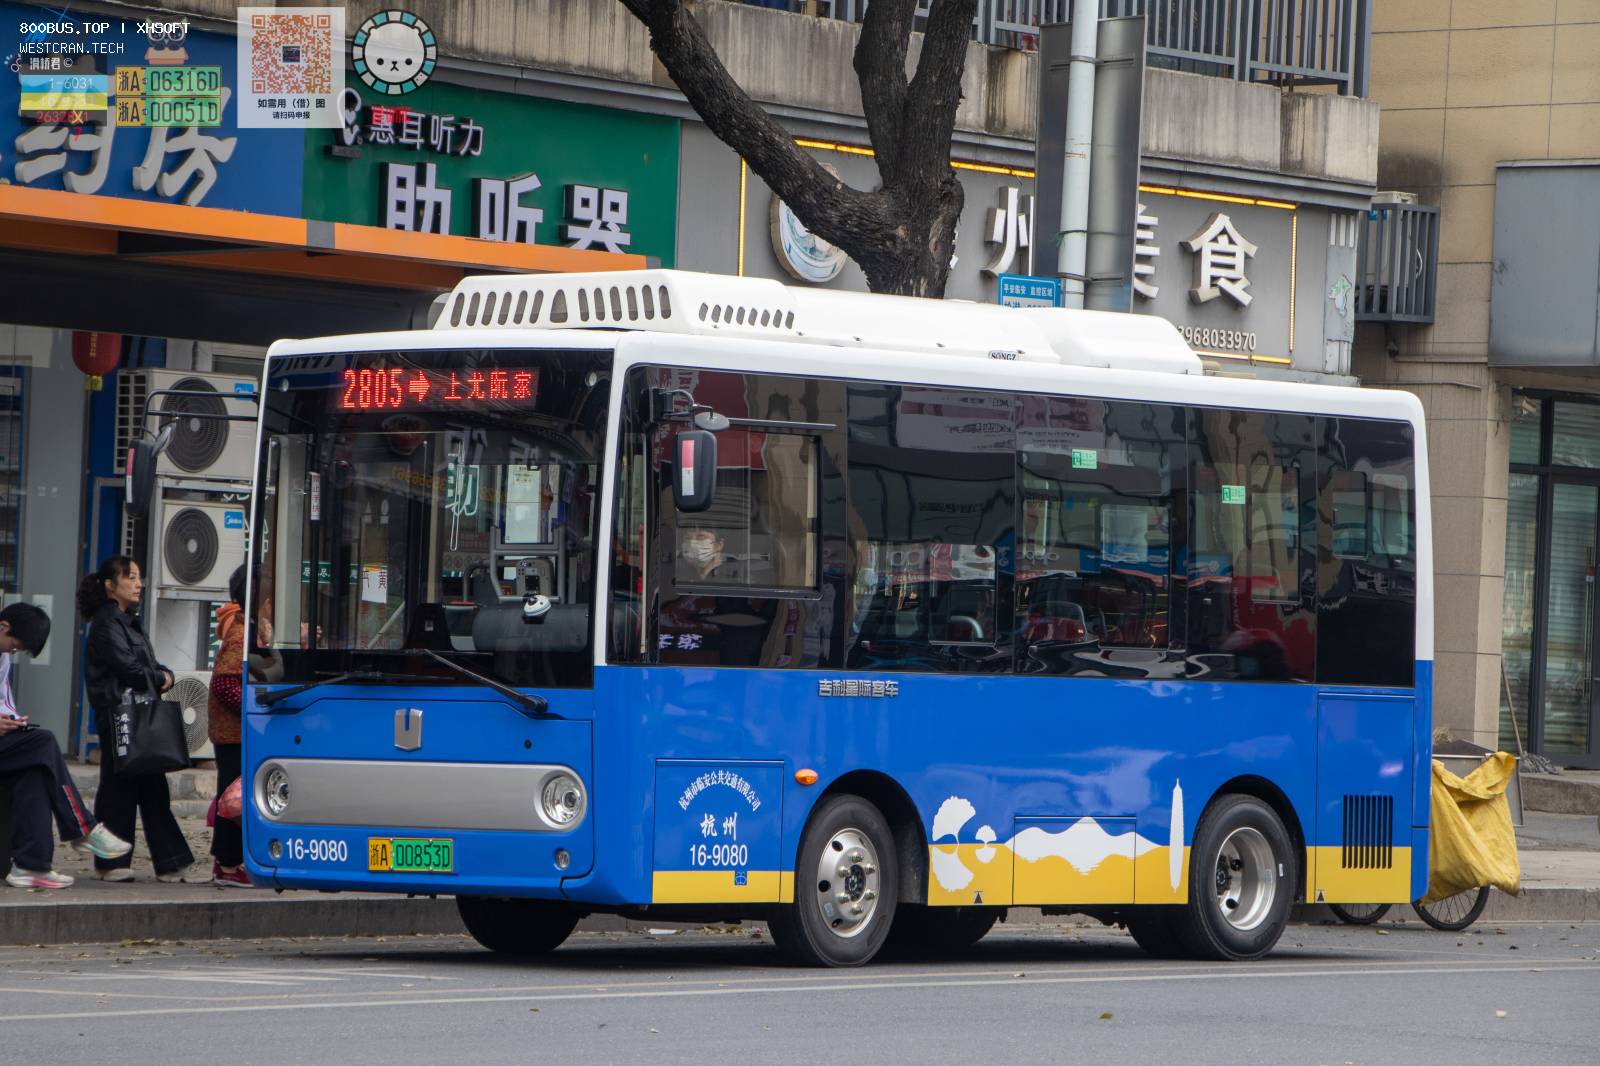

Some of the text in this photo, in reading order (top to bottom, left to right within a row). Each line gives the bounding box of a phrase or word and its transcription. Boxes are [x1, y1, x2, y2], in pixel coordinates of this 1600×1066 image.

[368, 105, 484, 156] 惠耳听力
[343, 369, 403, 408] 2805
[700, 811, 738, 841] 杭州
[286, 838, 348, 862] 16-9080
[690, 844, 748, 866] 16-9080
